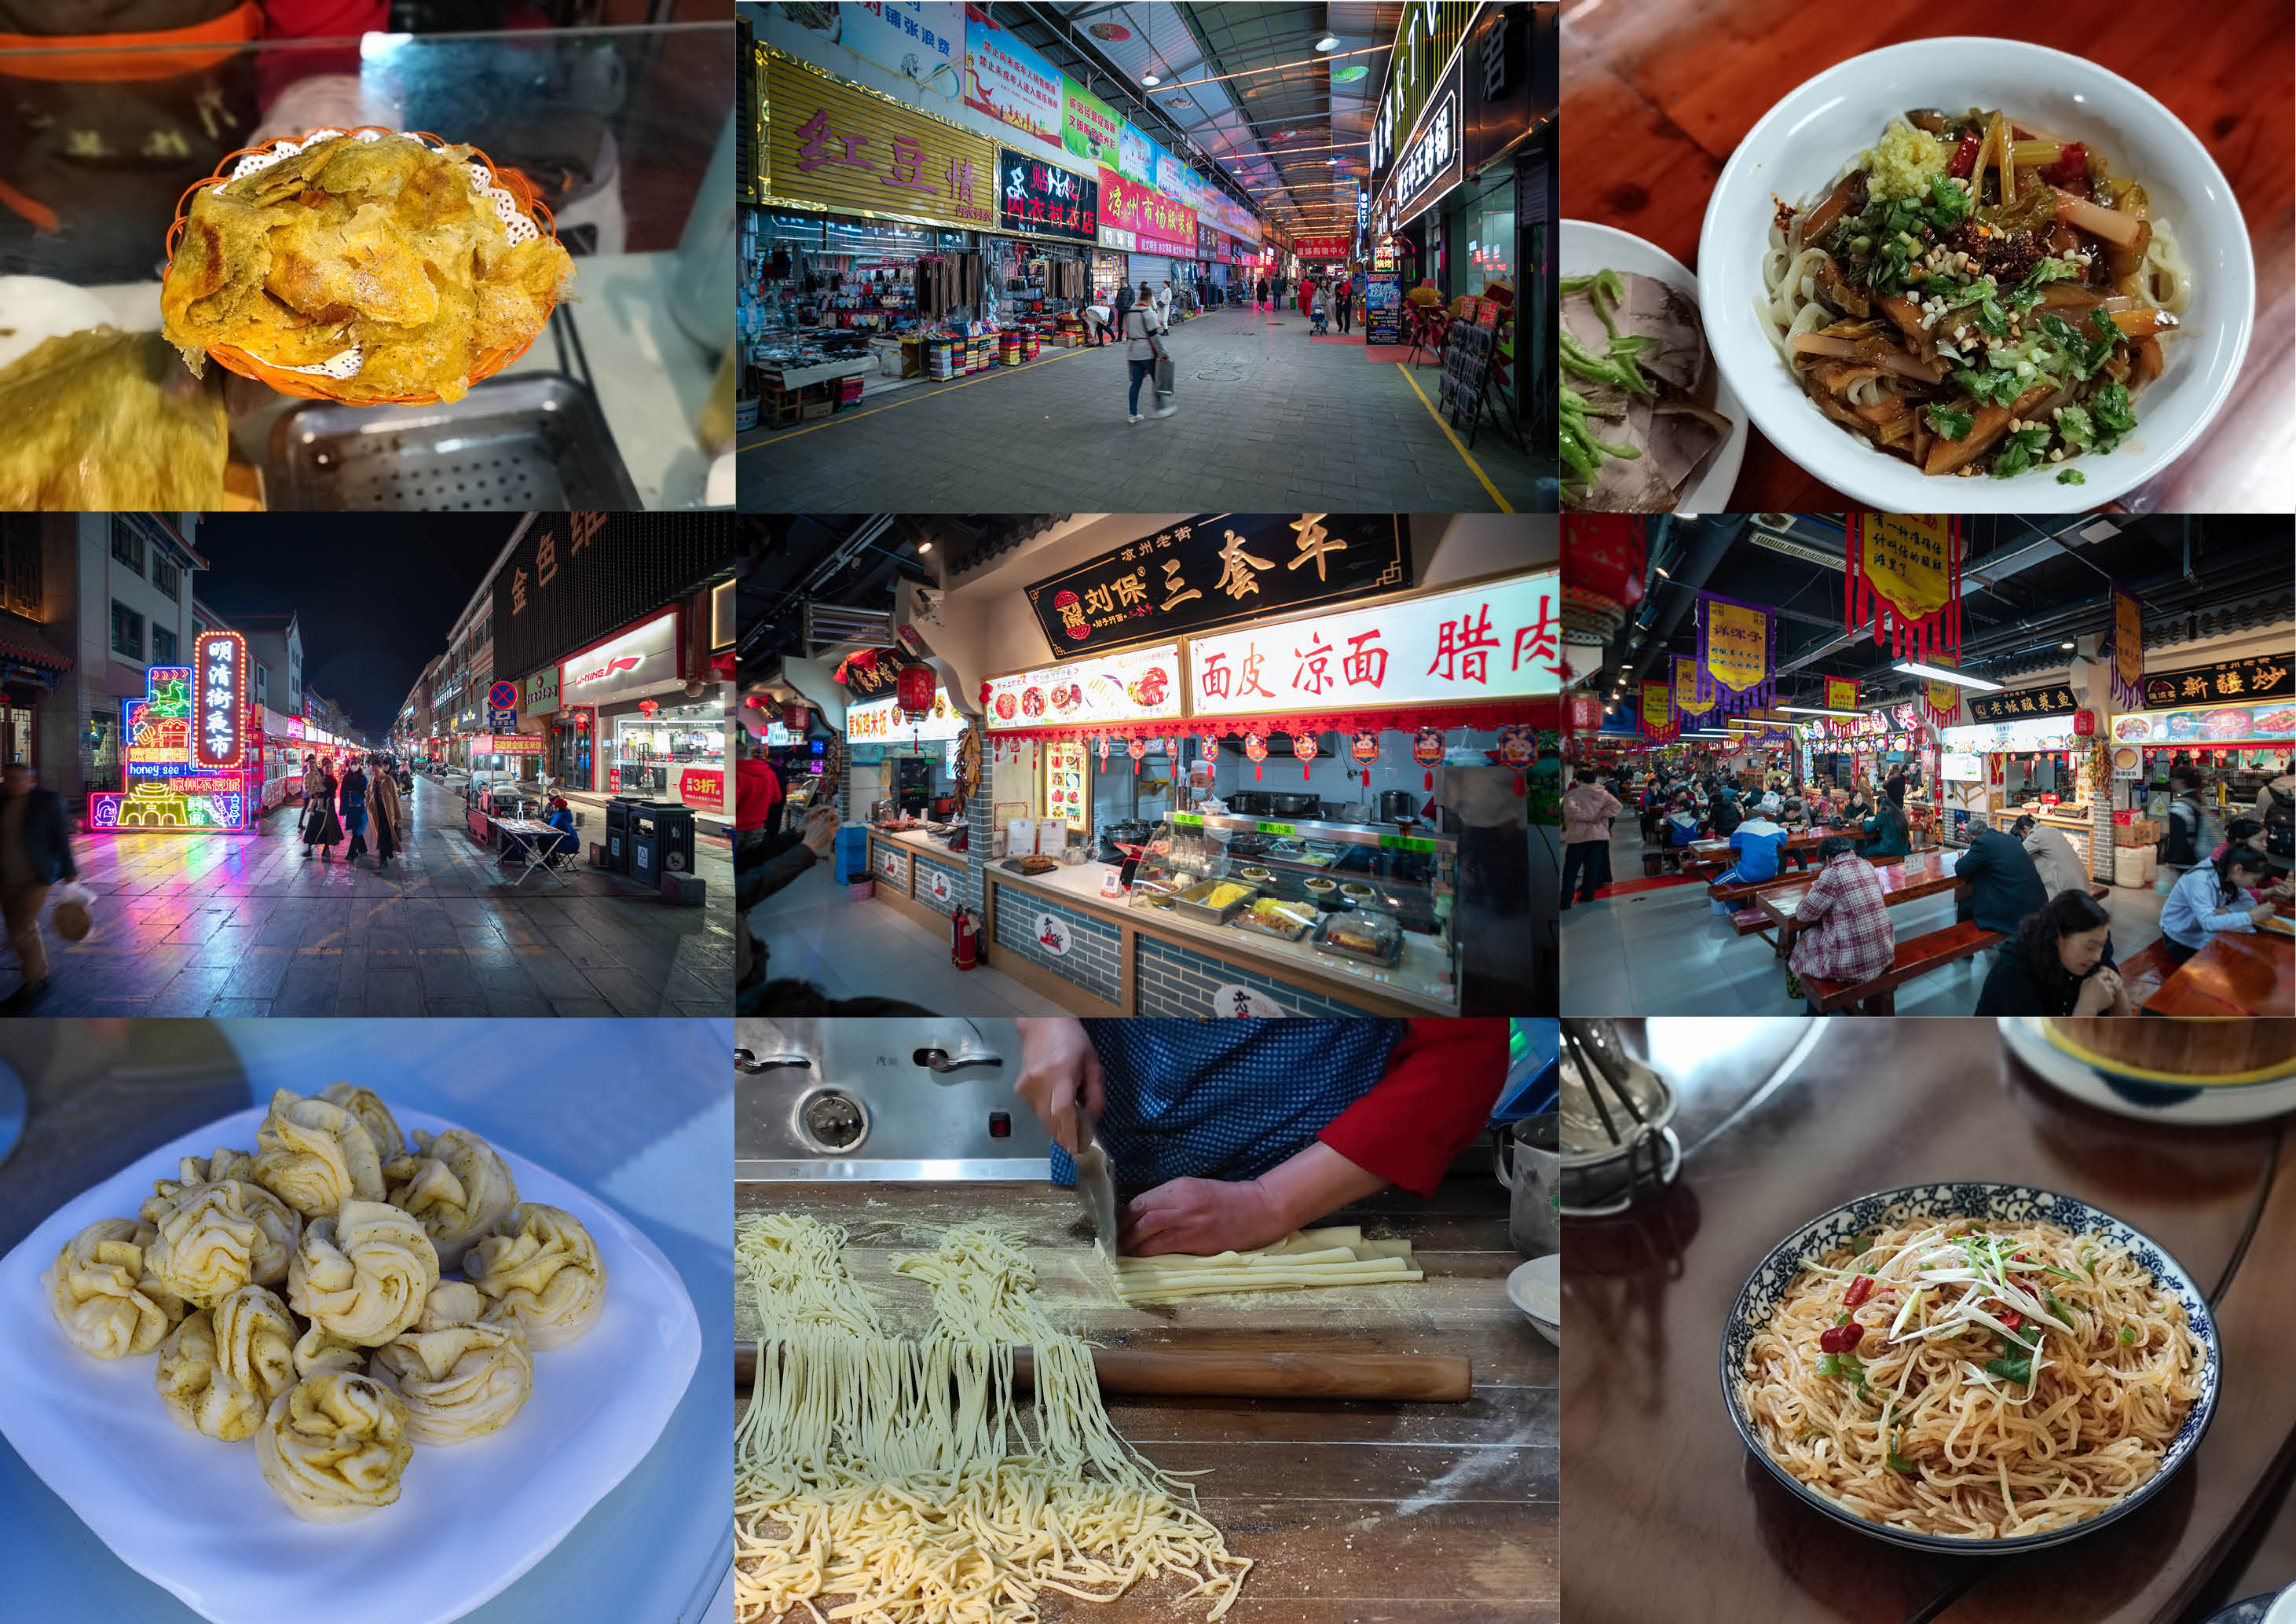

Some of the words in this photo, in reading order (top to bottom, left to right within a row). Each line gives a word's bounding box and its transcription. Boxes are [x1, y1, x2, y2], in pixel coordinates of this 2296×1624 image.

[980, 55, 1058, 109] 禁止未成年人进入娱乐场所
[1068, 95, 1116, 134] 诚信经营促发展
[1068, 114, 1115, 151] 文明服务添光彩
[796, 108, 979, 206] 红豆情
[1006, 195, 1095, 235] 内衣衬衣店
[1108, 185, 1195, 240] 凉州市场服装城
[1297, 246, 1346, 255] 服饰购物中心
[1121, 526, 1192, 563] 凉州老街
[1159, 513, 1349, 611] 三套车
[1084, 574, 1148, 614] 刘保
[1202, 641, 1276, 700] 面皮
[1291, 628, 1389, 695] 凉面
[1426, 595, 1560, 685] 腊肉
[206, 640, 234, 760] 明清街夜市
[2181, 666, 2287, 699] 新疆炒
[1990, 691, 2074, 716] 老坛酸菜鱼
[848, 709, 888, 739] 黄焖鸡米饭
[130, 763, 159, 776] honey
[170, 777, 241, 792] 凉州不夜城
[187, 797, 204, 825] 美食
